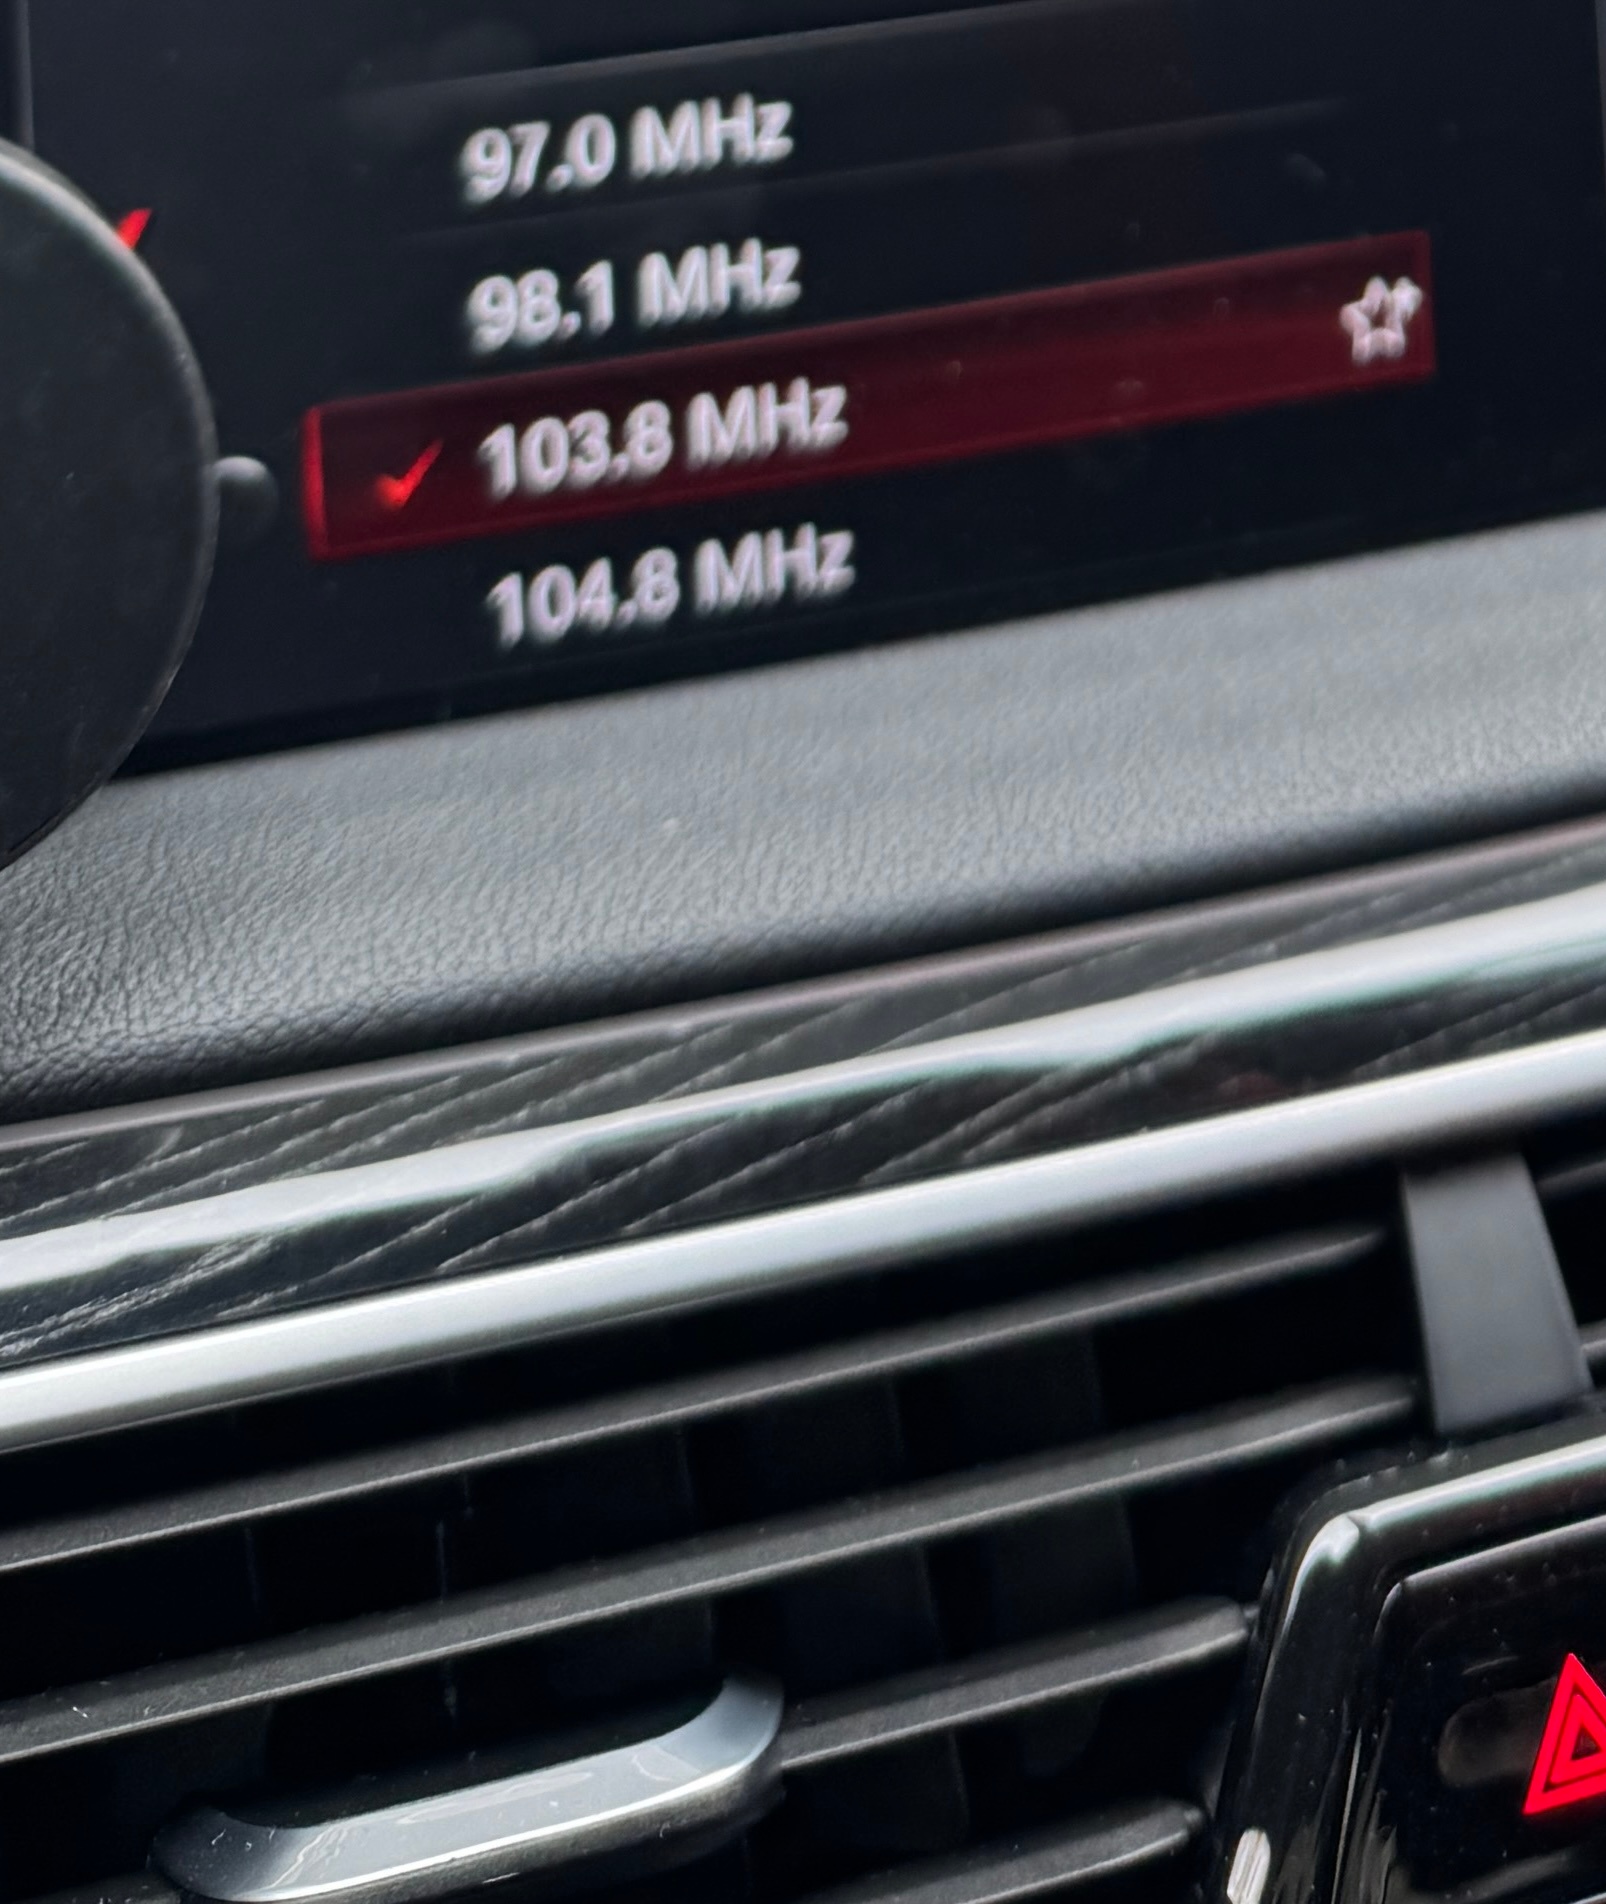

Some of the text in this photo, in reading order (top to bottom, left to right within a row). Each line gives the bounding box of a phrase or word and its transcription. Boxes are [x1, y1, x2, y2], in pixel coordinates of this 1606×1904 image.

[459, 92, 795, 206] 97.0 MHz
[465, 237, 803, 354] 98.1 MHz
[478, 376, 850, 501] 103.8 MHz
[487, 522, 856, 650] 104.8 MHz
